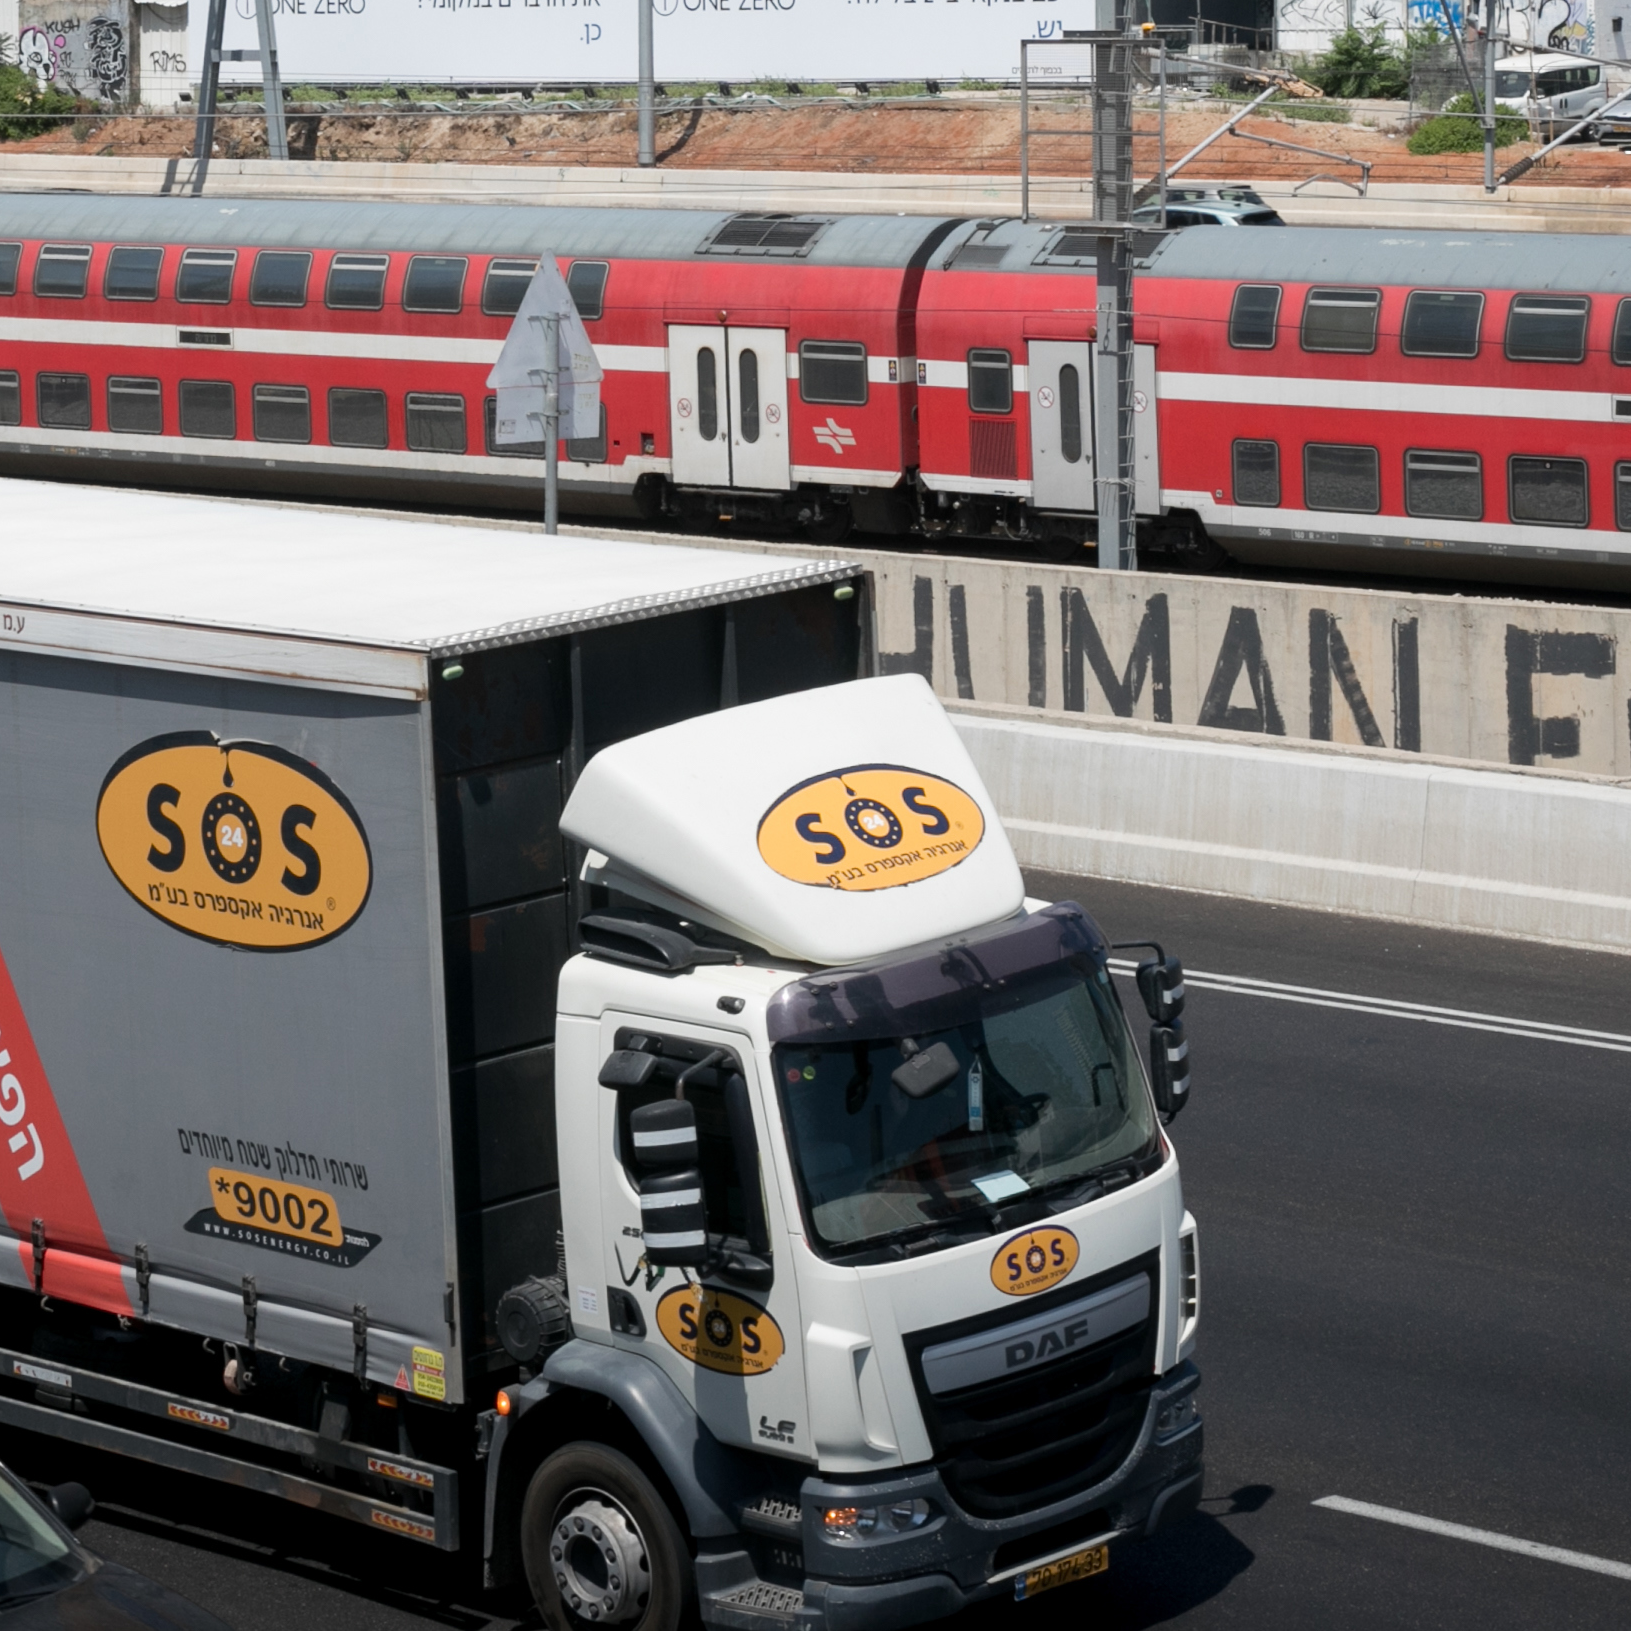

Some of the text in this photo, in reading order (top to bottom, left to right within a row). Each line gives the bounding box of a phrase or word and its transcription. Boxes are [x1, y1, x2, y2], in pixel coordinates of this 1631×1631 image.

[579, 22, 602, 45] כן.
[1032, 19, 1063, 40] יש.
[3, 613, 25, 635] ע.מ
[147, 782, 322, 896] SOS
[221, 825, 244, 847] 24
[795, 786, 950, 865] SOS
[863, 813, 885, 831] 24
[826, 839, 968, 887] אנרגיה אקספרס בע"מ
[148, 882, 325, 931] אנרגיה אקספרס בע"מ
[178, 1128, 368, 1191] שרותי תדלוק שטח מיוחדים
[204, 1222, 350, 1266] WWW.SOSENERGY.CO.IL
[1007, 1237, 1065, 1281] SOS
[679, 1303, 761, 1354] SOS
[1005, 1319, 1089, 1368] DAF
